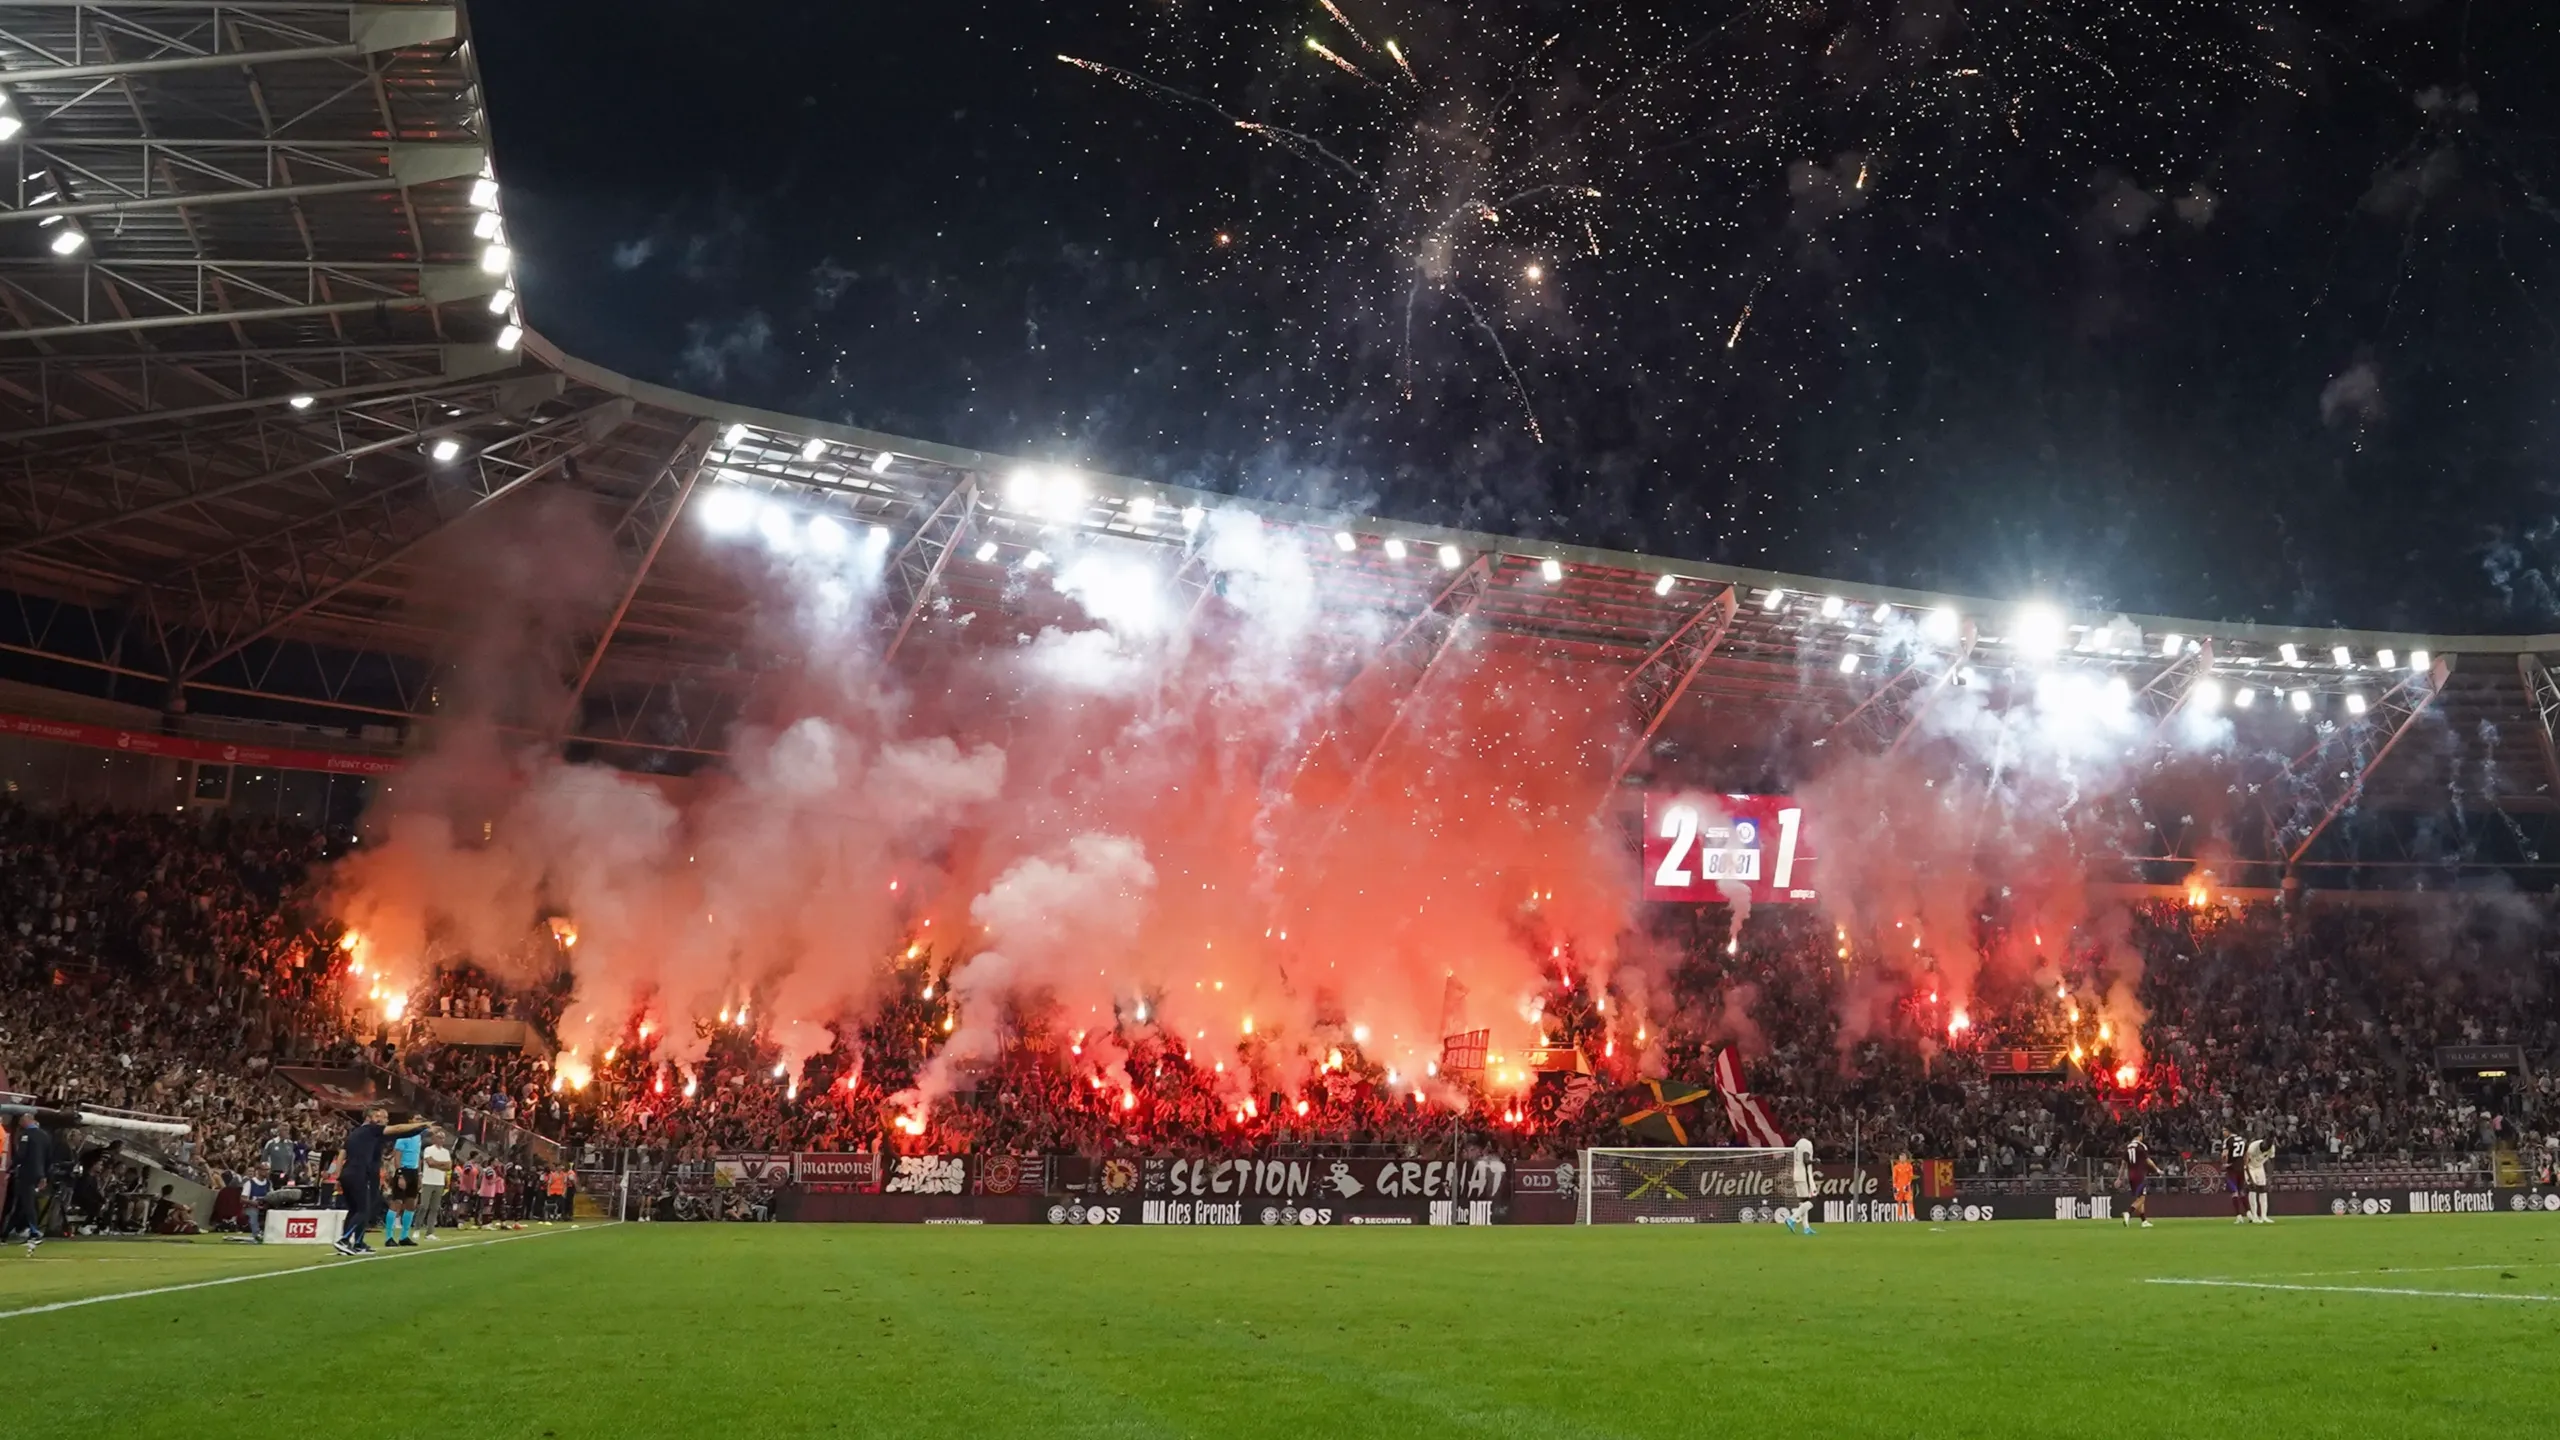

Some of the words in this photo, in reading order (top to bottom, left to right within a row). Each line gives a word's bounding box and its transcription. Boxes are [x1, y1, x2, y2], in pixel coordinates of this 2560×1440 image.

[1655, 806, 1698, 886] 2
[1773, 808, 1801, 888] 1
[1170, 1158, 1311, 1197] SECTION
[1377, 1161, 1506, 1198] GRENAT
[1522, 1174, 1551, 1188] OLD
[1700, 1170, 1773, 1196] Vieille
[1846, 1199, 1868, 1222] ds
[2055, 1196, 2077, 1219] SAVE
[2077, 1201, 2091, 1217] the
[2091, 1196, 2112, 1219] DATE
[2409, 1191, 2430, 1212] GALA
[2431, 1190, 2451, 1212] des
[2454, 1189, 2494, 1212] Grenat
[1142, 1200, 1166, 1225] GALA
[1167, 1200, 1191, 1224] des
[1195, 1200, 1242, 1225] Grenat
[1365, 1217, 1412, 1225] SECURITAS
[1429, 1200, 1453, 1226] SAVE
[1456, 1205, 1469, 1224] he
[1469, 1200, 1493, 1226] DATE
[1649, 1216, 1695, 1224] SECURITAS
[288, 1222, 315, 1234] RTS
